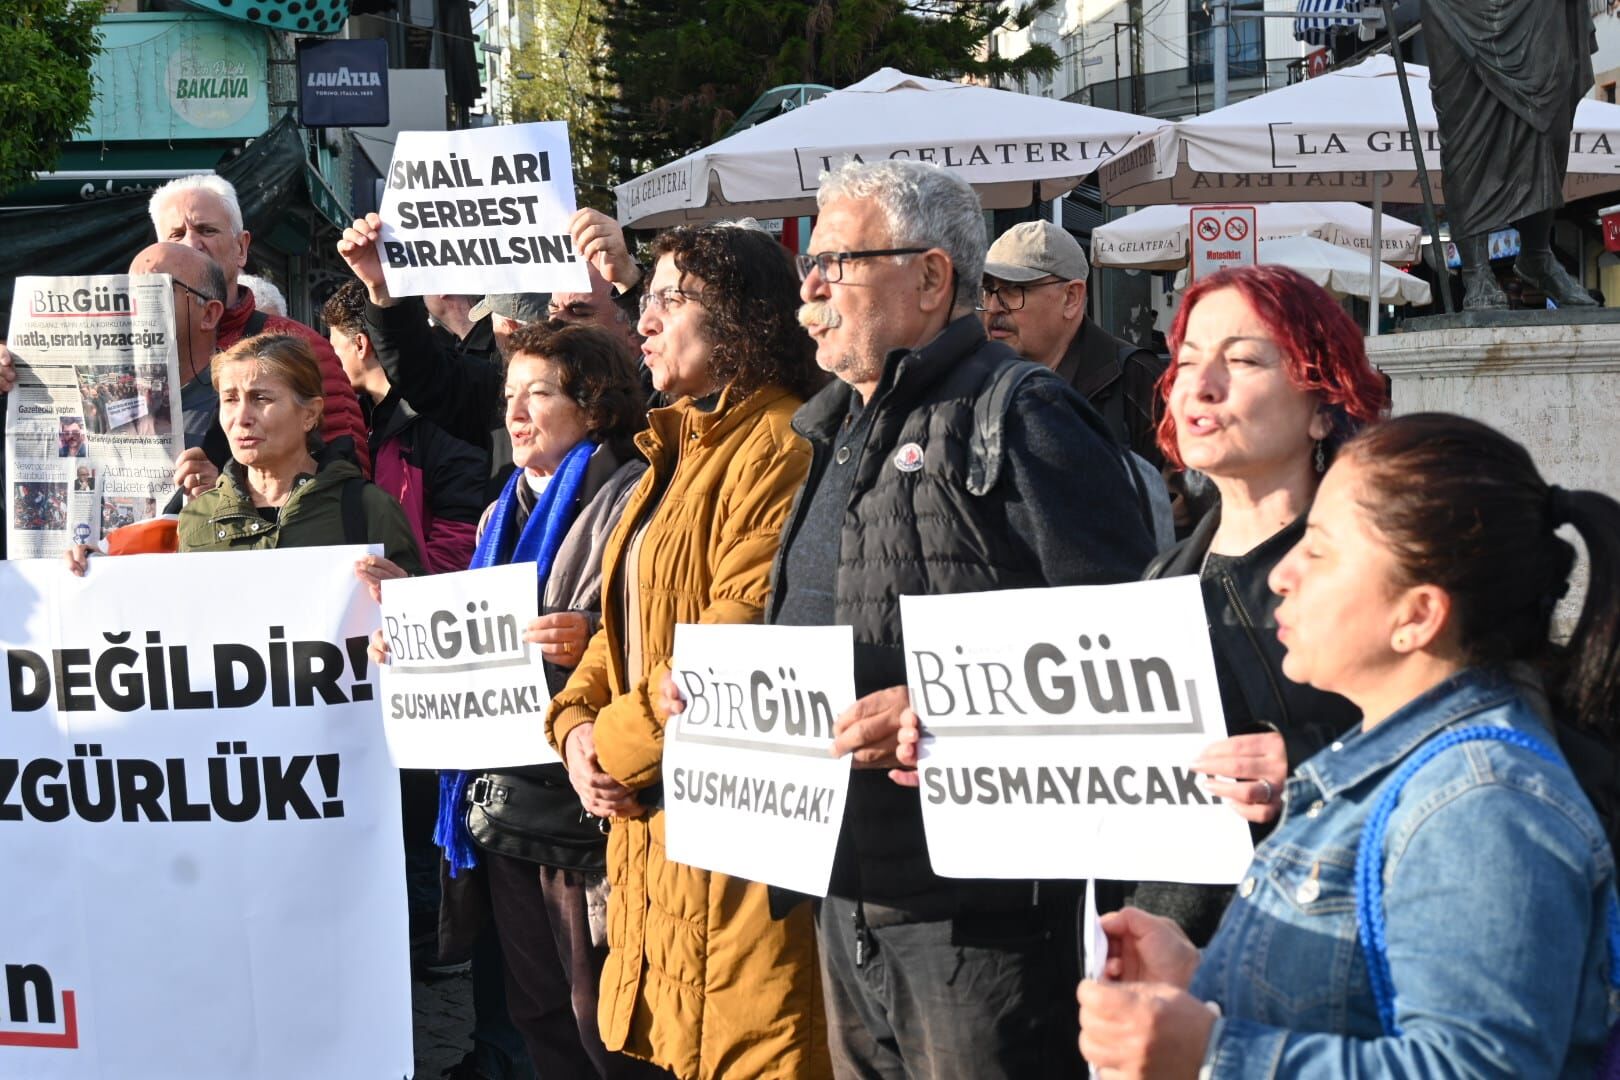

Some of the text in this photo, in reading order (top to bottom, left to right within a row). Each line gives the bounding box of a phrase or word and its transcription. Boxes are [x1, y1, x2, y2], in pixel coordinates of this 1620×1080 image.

[176, 78, 249, 99] BAKLAVA
[307, 66, 381, 87] LAVAZZA
[1294, 132, 1350, 155] LA
[491, 151, 551, 186] ARI
[631, 169, 687, 207] LA GELATERIA
[397, 195, 538, 230] SERBEST
[384, 234, 576, 269] BIRAKILSIN!
[1101, 240, 1174, 253] LA GELATERIA
[1206, 250, 1241, 260] Motosiklet
[1353, 237, 1411, 249] GELTERIA
[95, 329, 165, 350] yazacağız
[7, 625, 374, 713] DEĞİLDİR!
[391, 685, 541, 720] SUSMAYACAK!
[673, 767, 835, 824] SUSMAYACAK!
